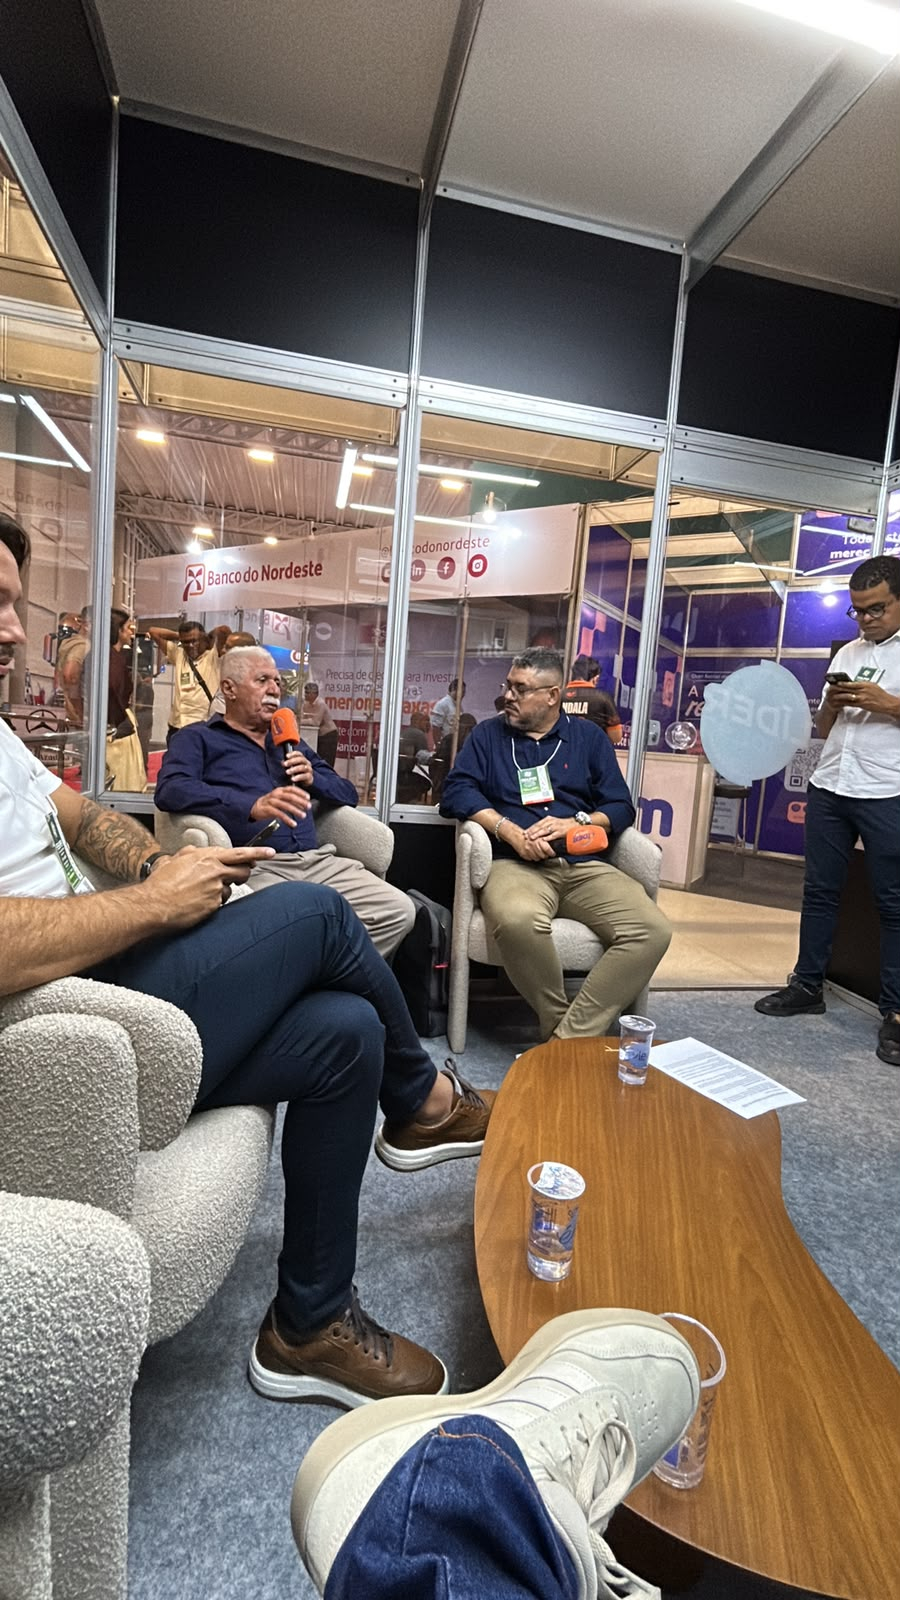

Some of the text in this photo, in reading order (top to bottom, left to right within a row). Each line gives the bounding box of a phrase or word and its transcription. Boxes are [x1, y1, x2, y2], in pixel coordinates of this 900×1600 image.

[381, 537, 491, 558] @odonordeste
[207, 560, 323, 586] Banco do Nordeste
[326, 669, 354, 680] Precisa
[356, 669, 367, 680] de
[407, 673, 421, 682] ara
[337, 684, 351, 693] sua
[325, 697, 381, 711] menore
